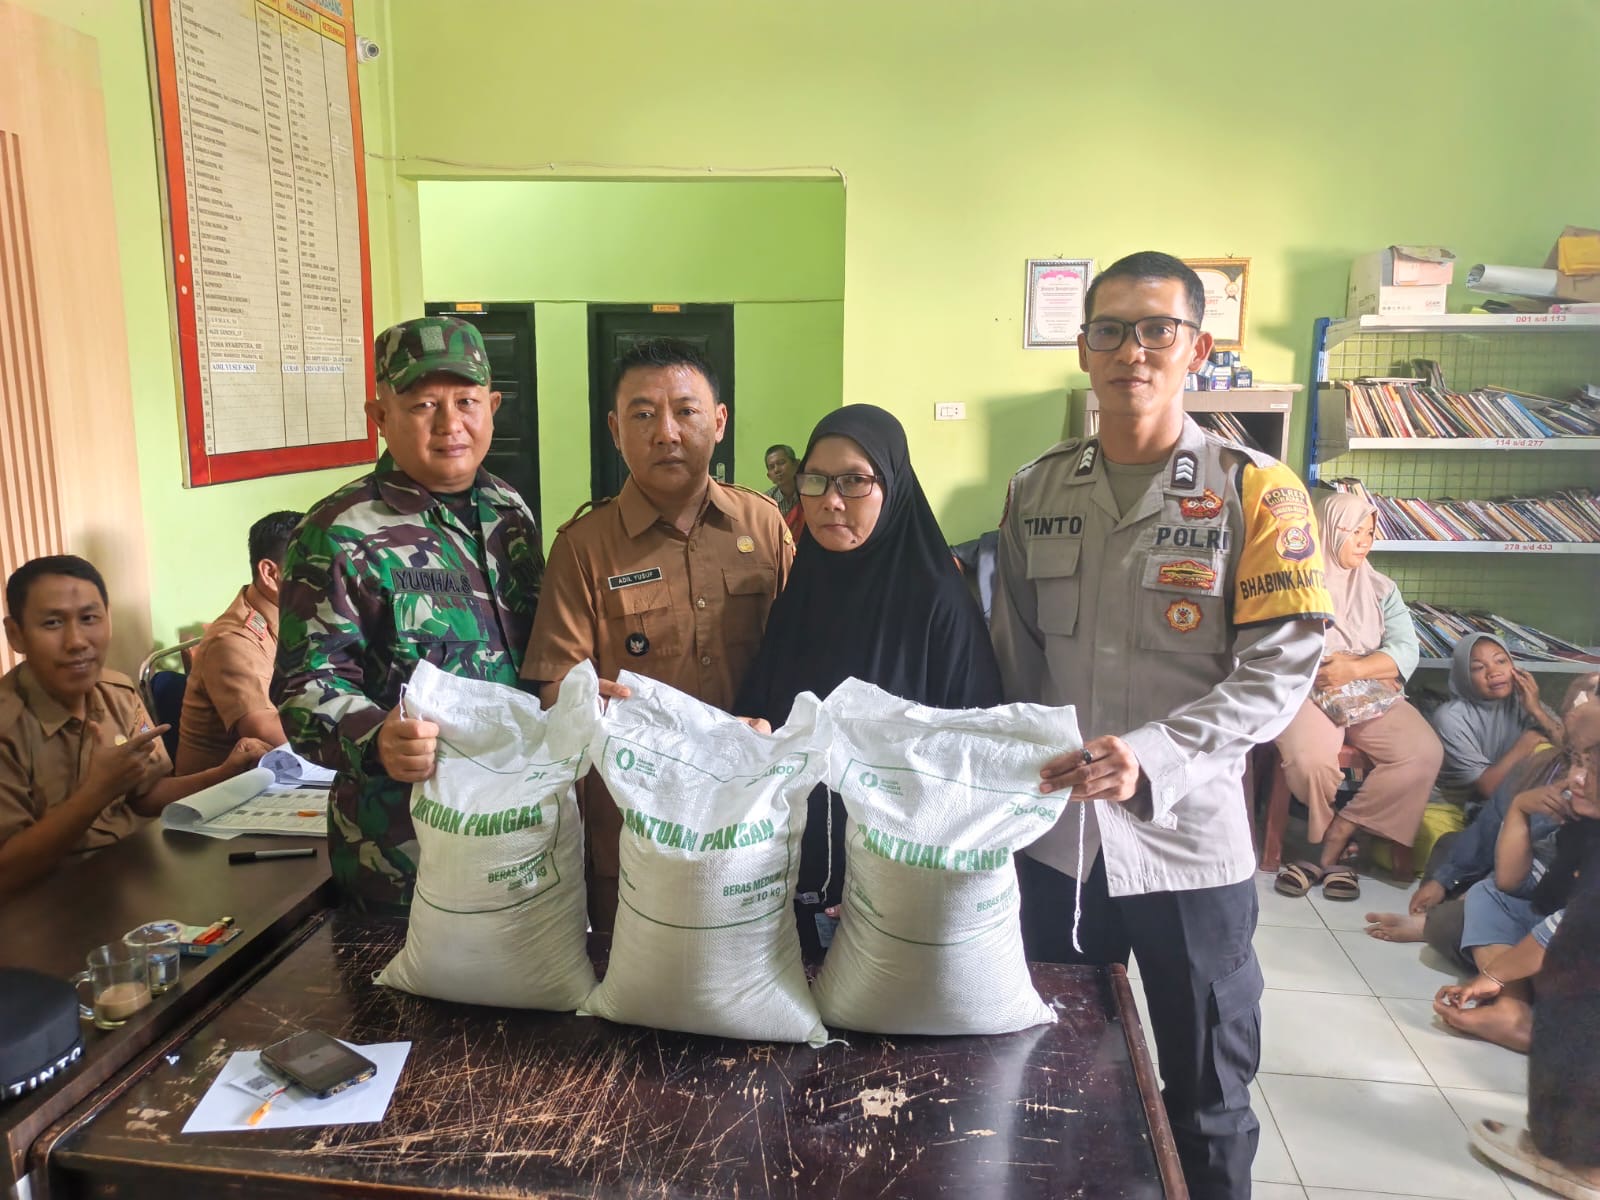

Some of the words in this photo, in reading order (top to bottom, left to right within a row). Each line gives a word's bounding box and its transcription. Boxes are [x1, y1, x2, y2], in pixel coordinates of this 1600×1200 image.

[1023, 516, 1083, 537] TINTO
[1155, 527, 1229, 550] POLRI
[618, 576, 632, 585] ADIL
[634, 571, 653, 581] YUSUF
[617, 806, 699, 852] ANTUAN
[723, 882, 752, 897] BERAS
[757, 890, 768, 902] 10
[770, 887, 781, 897] kg
